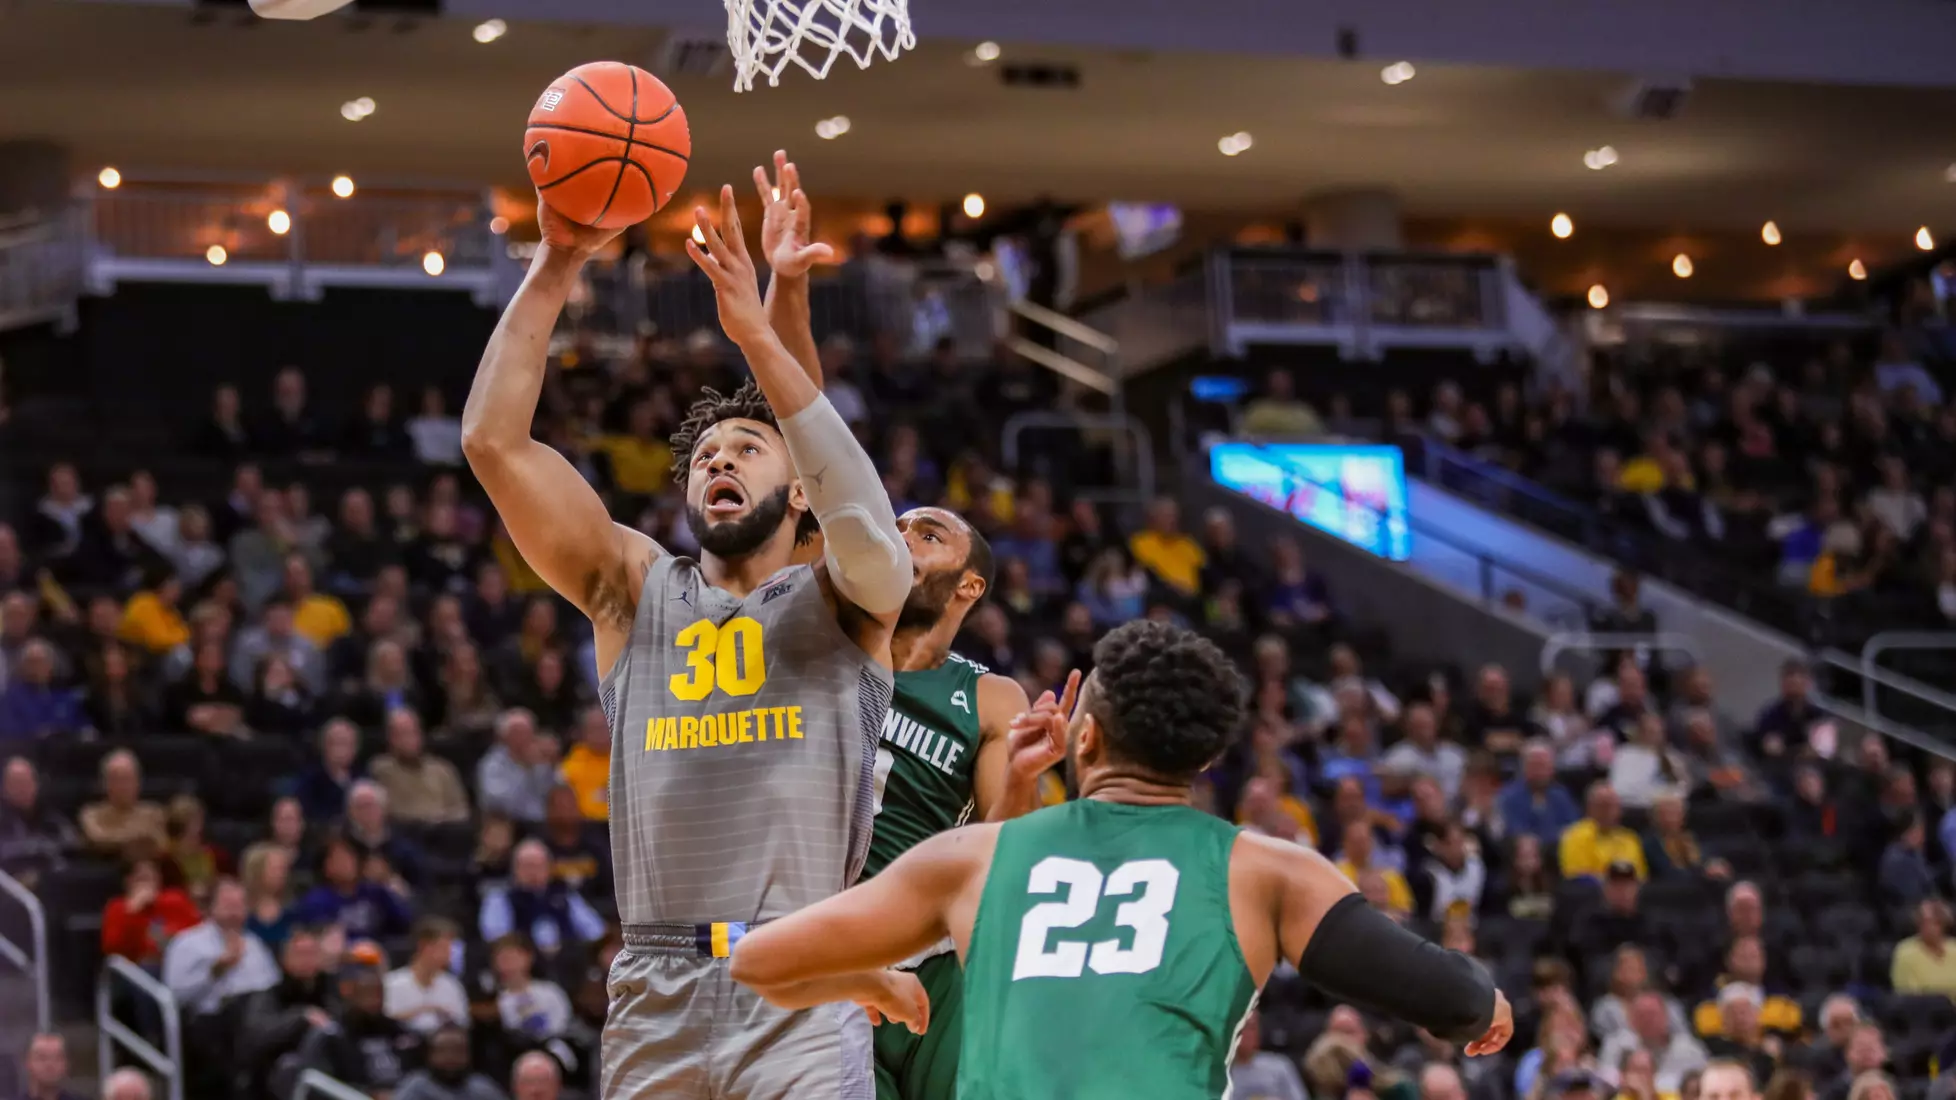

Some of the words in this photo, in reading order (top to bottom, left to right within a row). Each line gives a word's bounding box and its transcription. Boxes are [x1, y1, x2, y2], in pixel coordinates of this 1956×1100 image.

[669, 616, 767, 702] 30
[645, 705, 804, 751] MARQUETTE
[1012, 856, 1180, 982] 23
